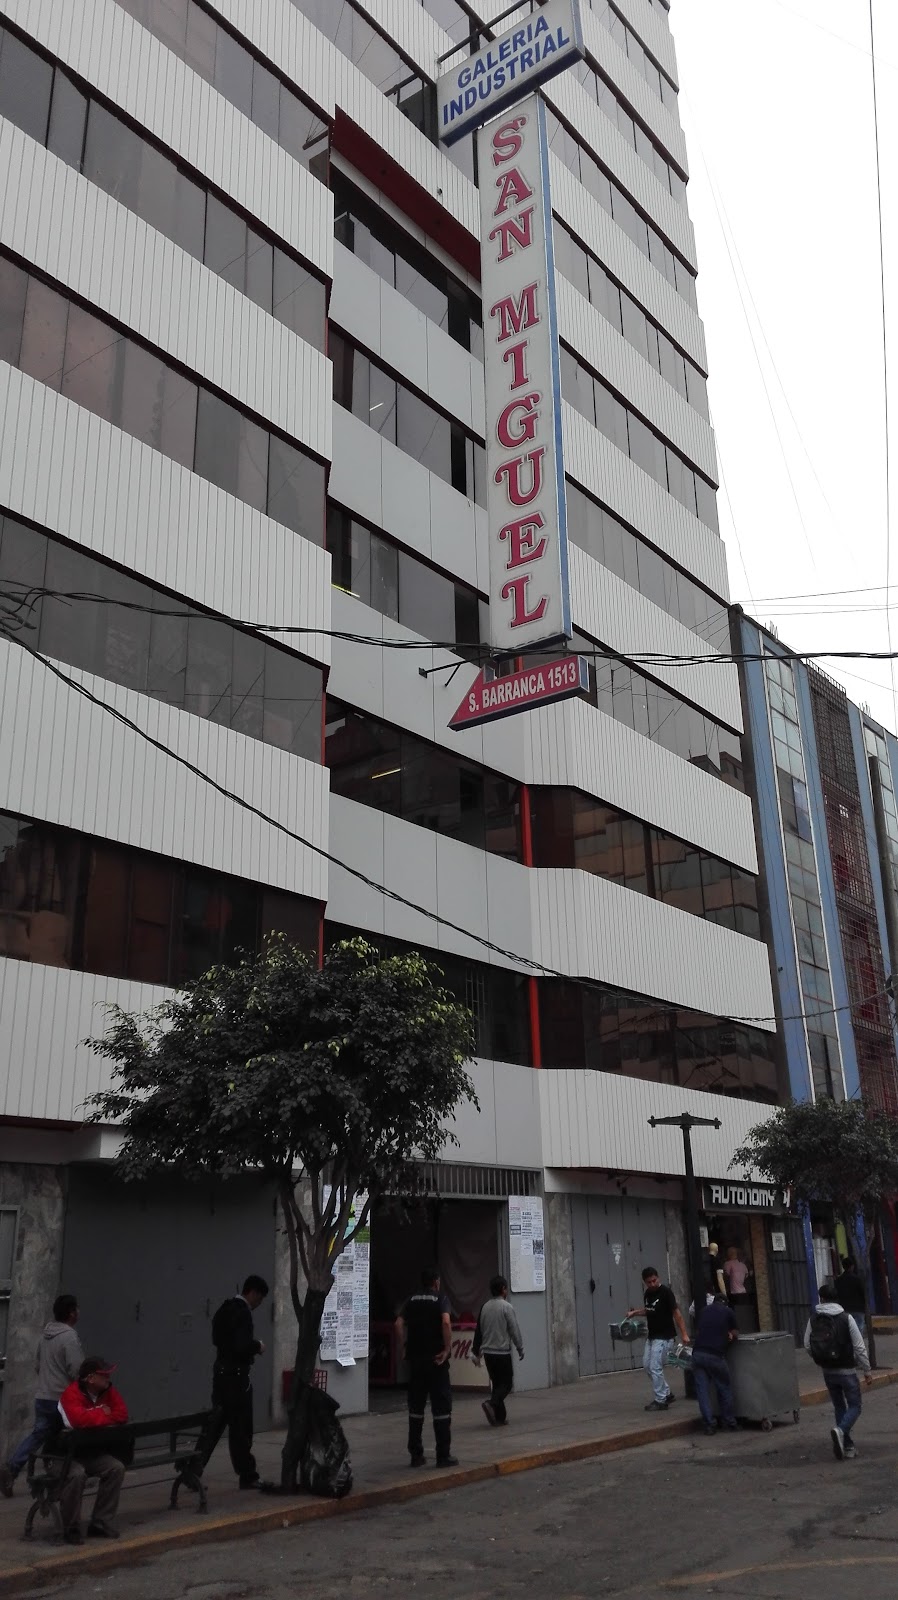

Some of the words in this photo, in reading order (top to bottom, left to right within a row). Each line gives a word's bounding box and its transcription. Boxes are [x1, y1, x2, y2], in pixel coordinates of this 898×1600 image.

[443, 26, 570, 126] INDUSTRIAL
[457, 15, 550, 89] GALERIA
[488, 115, 535, 263] SAN
[489, 280, 549, 630] MIGUEL
[468, 692, 480, 713] S.
[482, 672, 546, 709] BARRANCA
[547, 662, 576, 689] 1513
[710, 1184, 776, 1207] AUTONOMY
